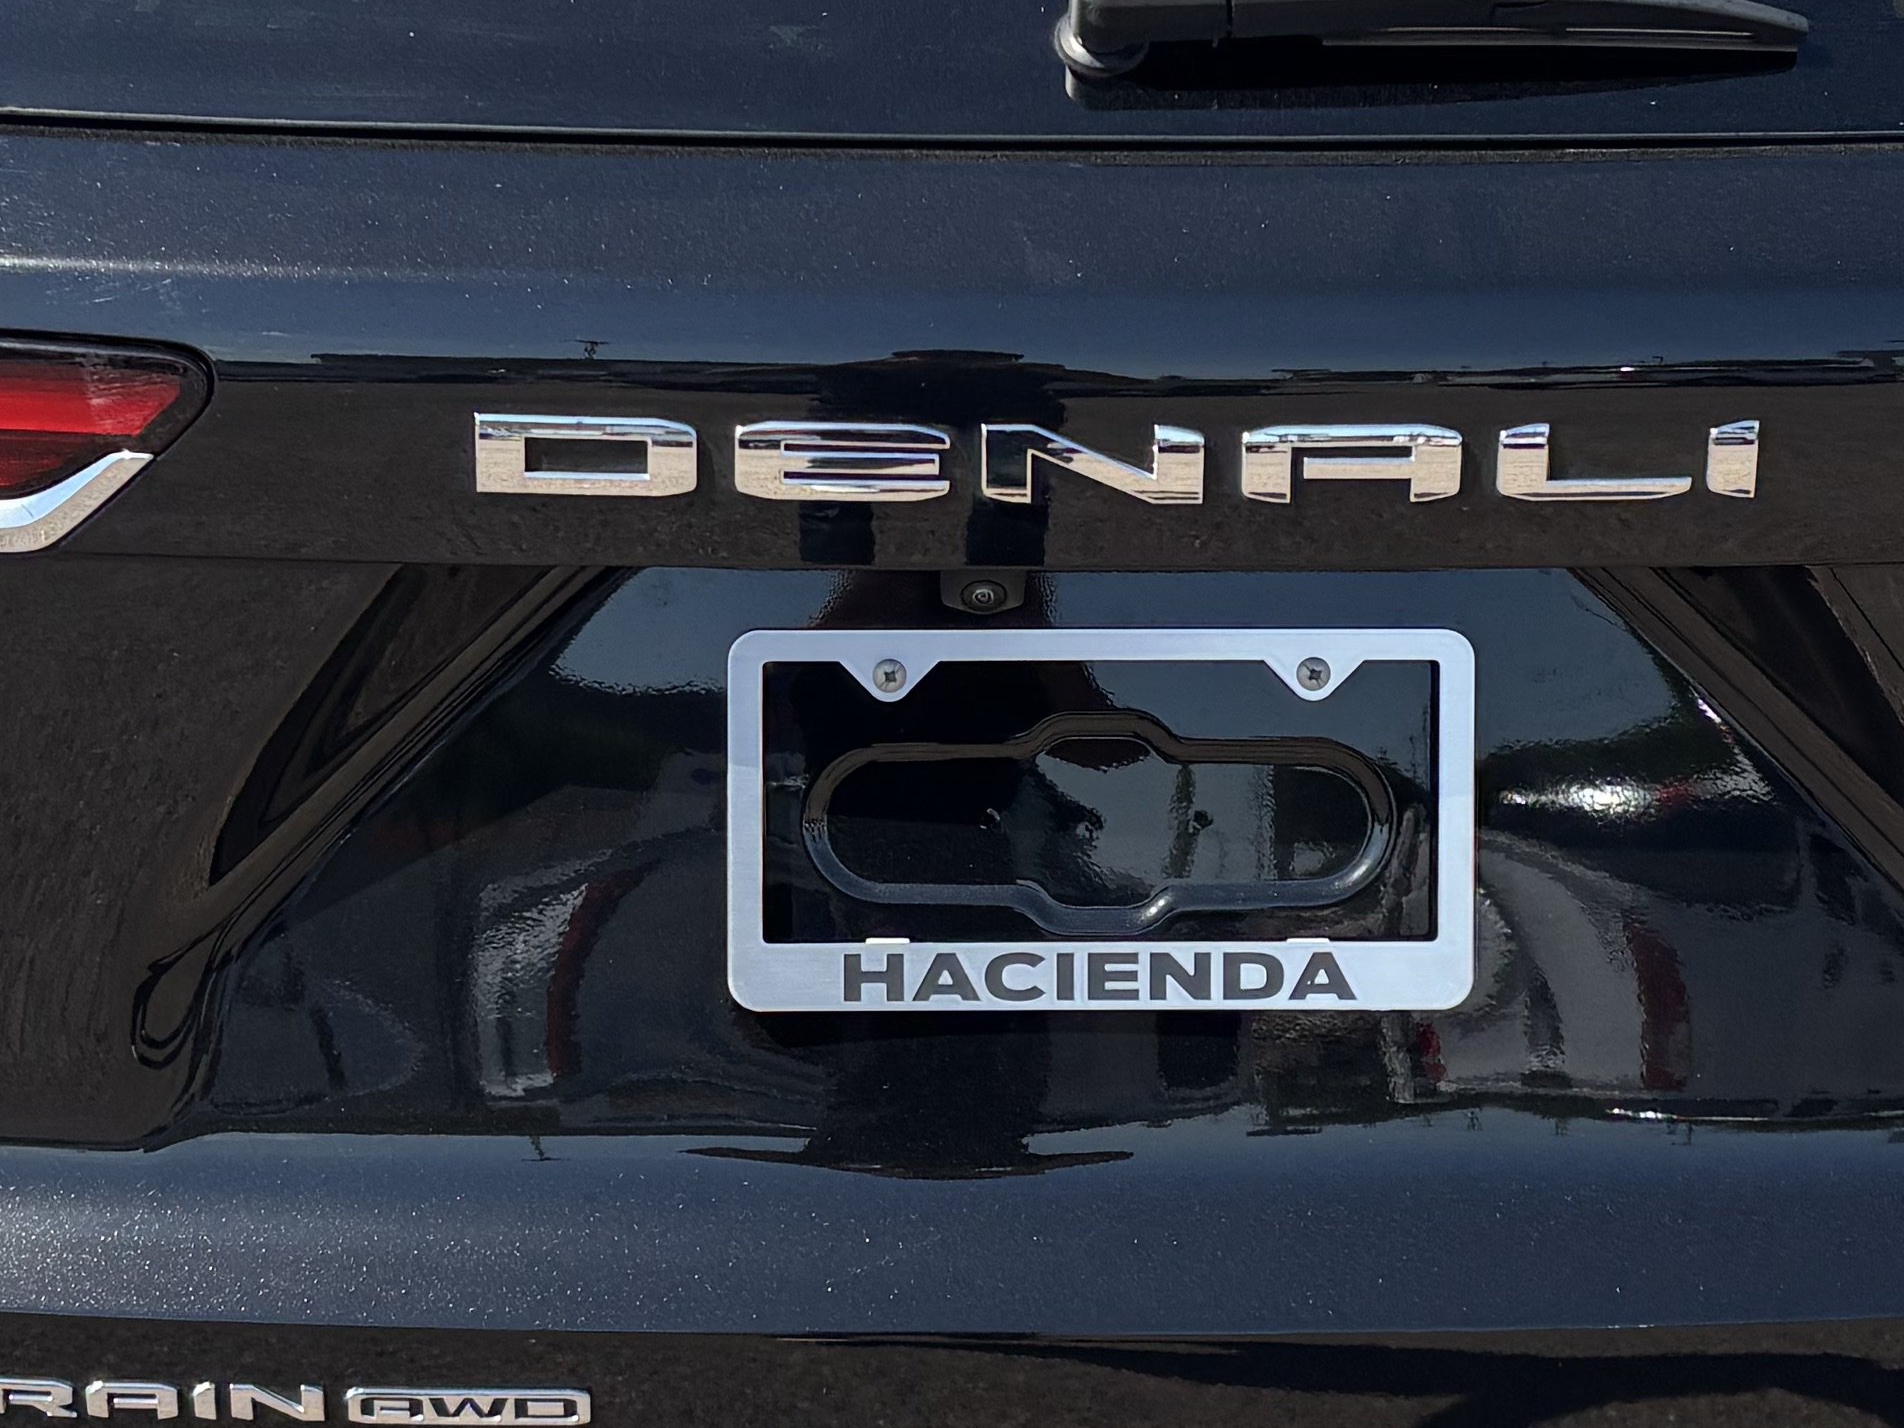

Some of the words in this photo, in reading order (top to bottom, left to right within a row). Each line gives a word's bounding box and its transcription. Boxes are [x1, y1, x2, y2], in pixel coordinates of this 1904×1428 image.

[475, 412, 1760, 505] DENALI
[843, 951, 1358, 1002] HACIENDA
[358, 1395, 583, 1423] AWD
